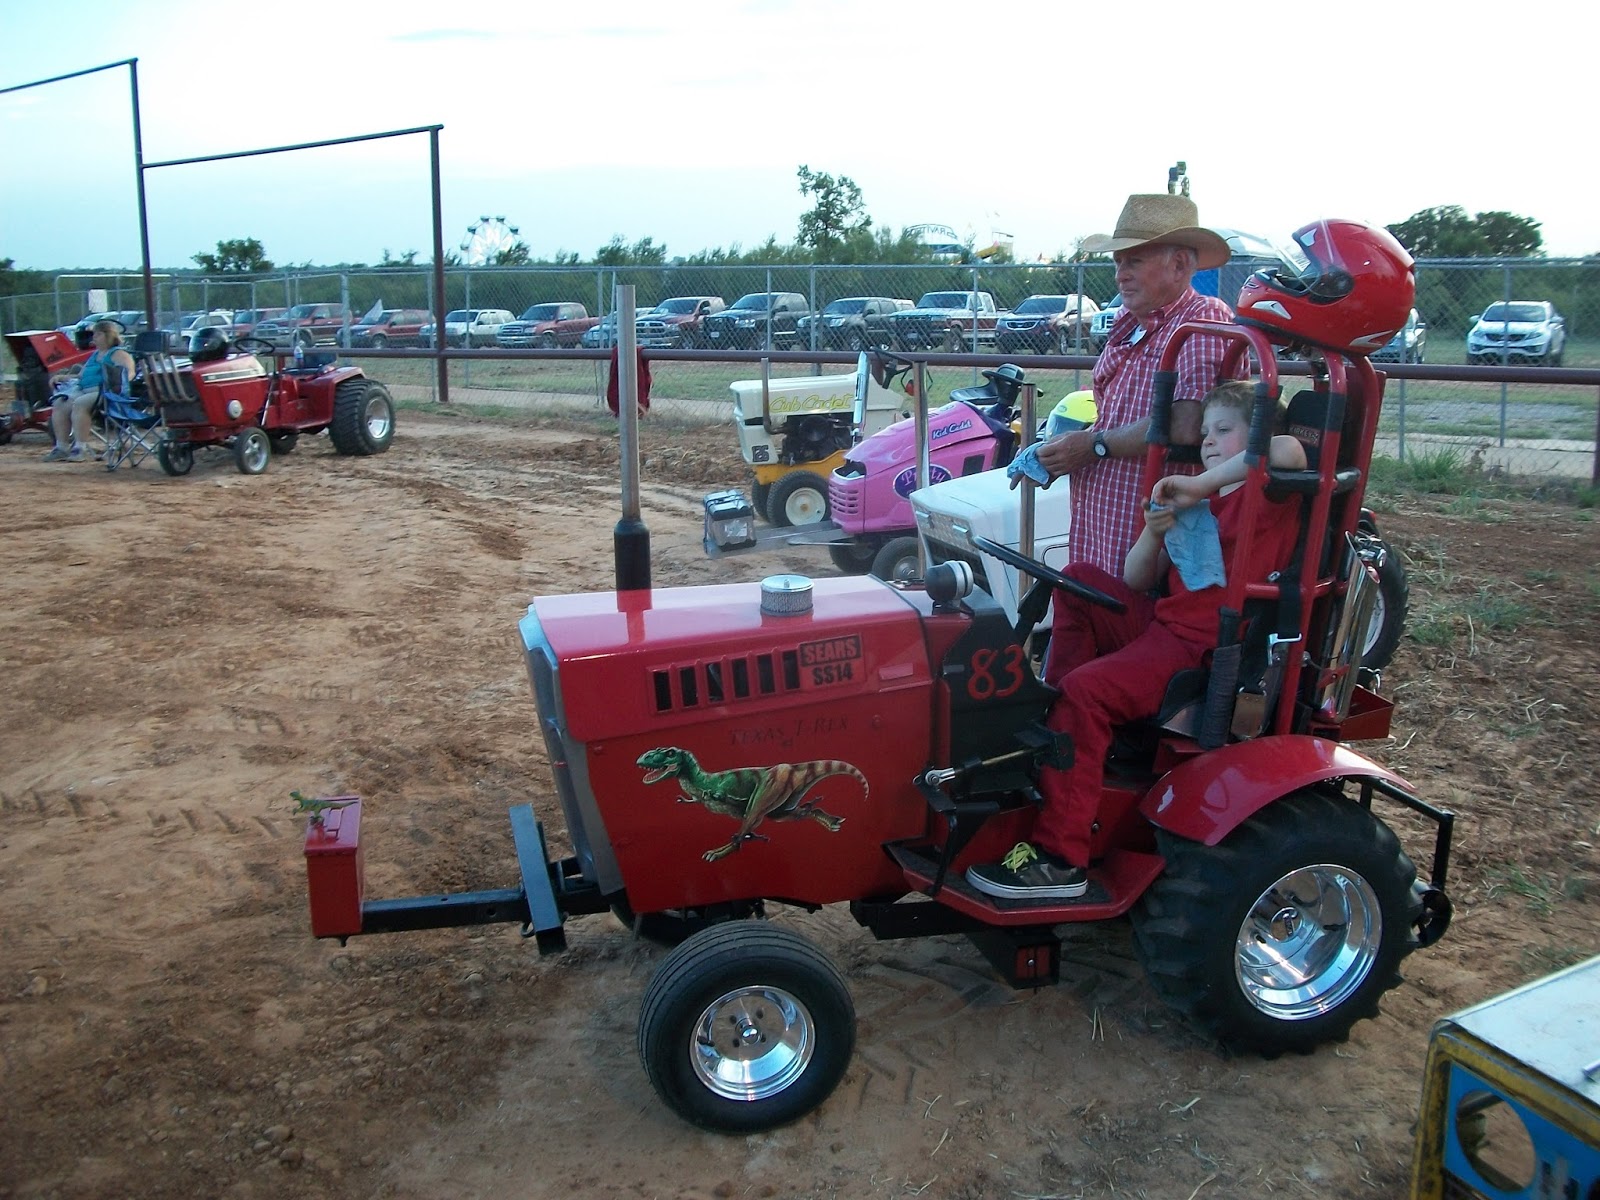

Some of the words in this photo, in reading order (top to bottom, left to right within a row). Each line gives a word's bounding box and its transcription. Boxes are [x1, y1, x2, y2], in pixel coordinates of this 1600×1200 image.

[769, 396, 801, 414] Cub
[802, 394, 854, 411] Cadet
[932, 428, 948, 440] Kid
[949, 419, 972, 434] Cadet
[804, 637, 858, 664] SEARS
[812, 661, 853, 686] SS14
[967, 644, 1024, 700] 83
